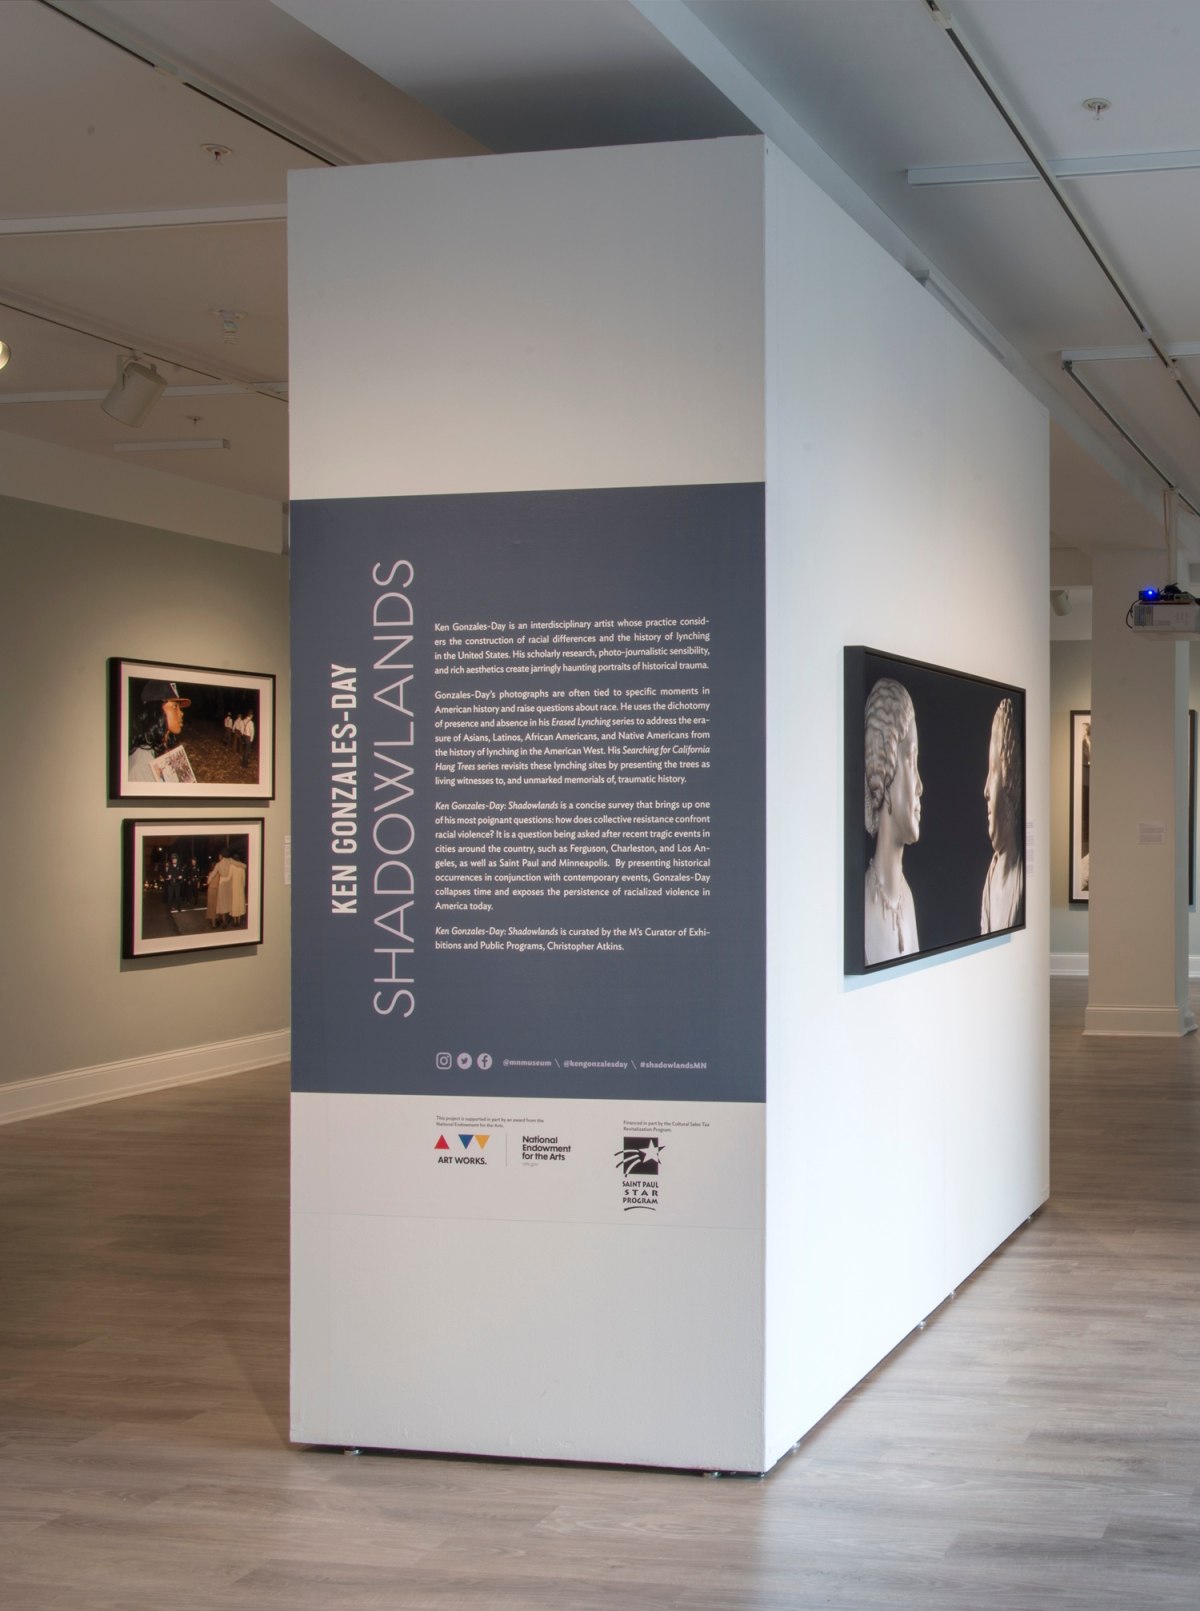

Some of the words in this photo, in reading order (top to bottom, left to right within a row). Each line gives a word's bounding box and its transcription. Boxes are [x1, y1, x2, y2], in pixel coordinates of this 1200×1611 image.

[434, 622, 449, 631] Ken
[452, 621, 506, 631] Gonzales-Day
[508, 621, 515, 630] is
[530, 619, 591, 630] interdisciplinary
[594, 619, 614, 627] artist
[617, 618, 642, 627] whose
[645, 617, 677, 628] practice
[679, 616, 709, 625] consid-
[448, 636, 462, 645] the
[464, 636, 514, 645] construction
[516, 635, 526, 644] of
[528, 634, 549, 644] racial
[552, 634, 596, 643] differences
[598, 633, 614, 642] and
[617, 633, 631, 642] the
[633, 632, 662, 642] history
[664, 631, 673, 640] of
[676, 631, 710, 642] lynching
[434, 651, 442, 660] in
[443, 651, 456, 660] the
[457, 650, 484, 659] United
[484, 650, 511, 659] States.
[512, 650, 526, 658] His
[526, 649, 561, 659] scholarly
[562, 648, 597, 658] research,
[598, 646, 668, 658] photo-journalistic
[669, 646, 710, 656] sensibility,
[434, 665, 449, 674] and
[450, 665, 465, 674] rich
[465, 664, 504, 674] aesthetics
[505, 665, 530, 673] create
[530, 663, 562, 674] jarringly
[562, 663, 597, 673] haunting
[597, 662, 631, 673] portraits
[632, 661, 641, 670] of
[641, 661, 678, 670] historical
[498, 689, 549, 700] photographs
[568, 688, 590, 697] often
[593, 687, 610, 696] tied
[625, 687, 656, 698] specific
[660, 687, 699, 695] moments
[702, 686, 710, 694] in
[452, 733, 462, 742] of
[462, 733, 491, 743] Asians,
[492, 733, 523, 742] Latinos,
[524, 732, 554, 741] African
[554, 732, 600, 741] Americans,
[600, 731, 616, 740] and
[618, 731, 645, 740] Native
[646, 730, 689, 739] Americans
[690, 730, 710, 739] from
[331, 664, 357, 854] GONZALES-DAY
[434, 776, 456, 787] living
[456, 776, 494, 784] witnesses
[495, 777, 506, 785] to,
[506, 775, 522, 784] and
[523, 775, 563, 784] unmarked
[563, 774, 605, 784] memorials
[606, 774, 617, 784] of,
[617, 774, 656, 783] traumatic
[657, 774, 687, 784] history.
[373, 560, 415, 1018] SHADOWLANDS
[435, 801, 449, 810] Ken
[451, 801, 506, 811] Gonzales-Day:
[508, 800, 558, 810] Shadowlands
[560, 800, 566, 809] is
[575, 800, 606, 809] concise
[608, 802, 634, 810] survey
[636, 800, 652, 808] that
[655, 800, 679, 811] brings
[682, 802, 692, 810] up
[484, 873, 492, 881] in
[494, 873, 541, 883] conjunction
[543, 872, 561, 881] with
[562, 874, 620, 883] contemporary
[621, 874, 651, 882] events,
[652, 872, 711, 883] Gonzales-Day
[331, 865, 357, 914] KEN
[434, 887, 471, 897] collapses
[473, 887, 492, 896] time
[494, 887, 510, 896] and
[512, 889, 544, 898] exposes
[546, 887, 561, 896] the
[563, 887, 610, 898] persistence
[612, 887, 621, 896] of
[623, 887, 662, 896] racialized
[665, 887, 700, 896] violence
[702, 887, 710, 895] in
[434, 901, 468, 910] America
[469, 901, 493, 912] today.
[435, 940, 462, 949] bitions
[463, 941, 478, 950] and
[480, 940, 504, 950] Public
[506, 941, 546, 952] Programs,
[546, 941, 595, 952] Christopher
[596, 941, 624, 950] Atkins.
[522, 1135, 558, 1143] National
[522, 1144, 571, 1152] Endowment
[454, 1156, 487, 1165] WORKS.
[535, 1152, 548, 1160] the
